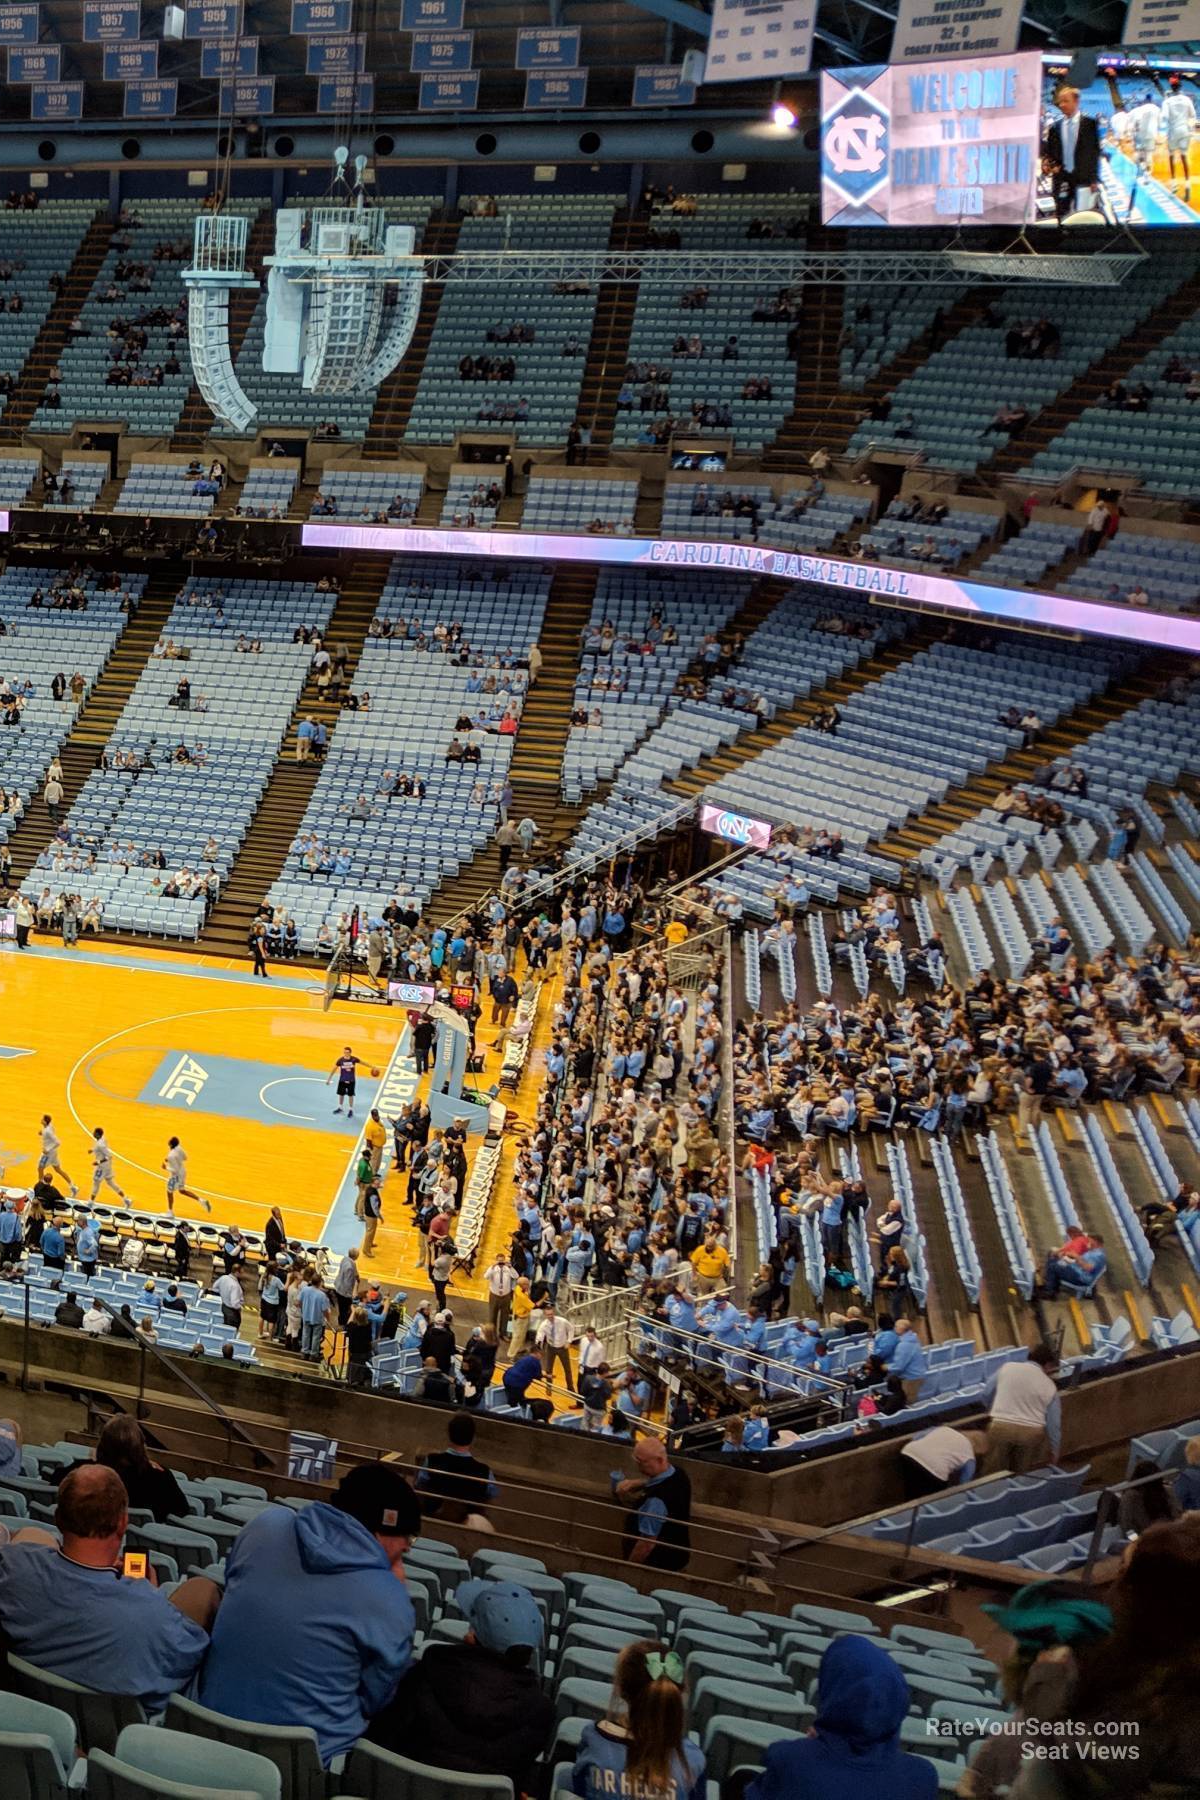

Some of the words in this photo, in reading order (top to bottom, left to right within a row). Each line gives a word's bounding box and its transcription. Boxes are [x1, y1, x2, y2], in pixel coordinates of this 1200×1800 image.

[909, 67, 1018, 113] WELCOME
[941, 119, 955, 139] TO
[960, 117, 982, 139] THE
[893, 145, 940, 185] DEAN
[966, 144, 1031, 184] SMITH
[935, 187, 984, 214] CENTER
[650, 543, 765, 571] CAROLINA
[772, 553, 909, 595] BASKETBALL
[166, 1058, 209, 1106] ACC
